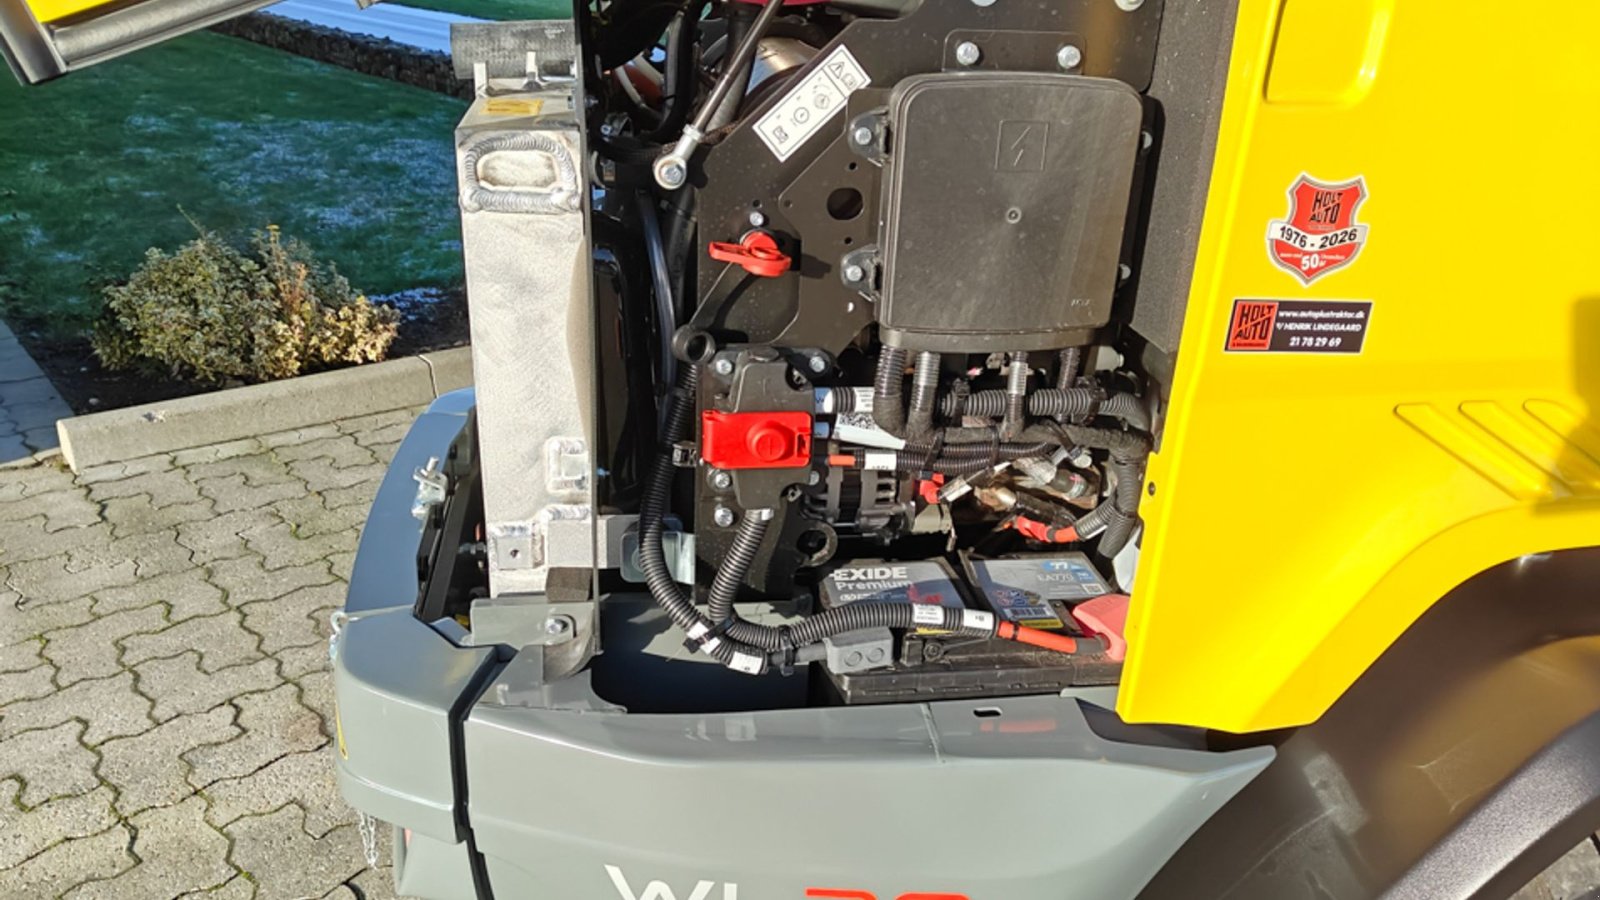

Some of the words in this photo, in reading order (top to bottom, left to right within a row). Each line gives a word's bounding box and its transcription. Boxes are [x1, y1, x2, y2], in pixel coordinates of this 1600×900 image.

[1312, 192, 1343, 212] HOLT
[1309, 203, 1341, 224] AUTO
[1280, 226, 1307, 248] 1976
[1318, 228, 1357, 249] 2026
[1301, 253, 1319, 271] 50
[1240, 305, 1274, 328] HOLT
[1234, 317, 1271, 340] AUTO
[1283, 322, 1312, 332] HENRIK
[1312, 323, 1362, 333] LINDEGAARD
[1289, 336, 1300, 347] 21
[1301, 336, 1313, 347] 78
[1314, 336, 1327, 347] 29
[1328, 337, 1342, 347] 69
[828, 566, 908, 581] EXIDE
[835, 580, 912, 591] Premium
